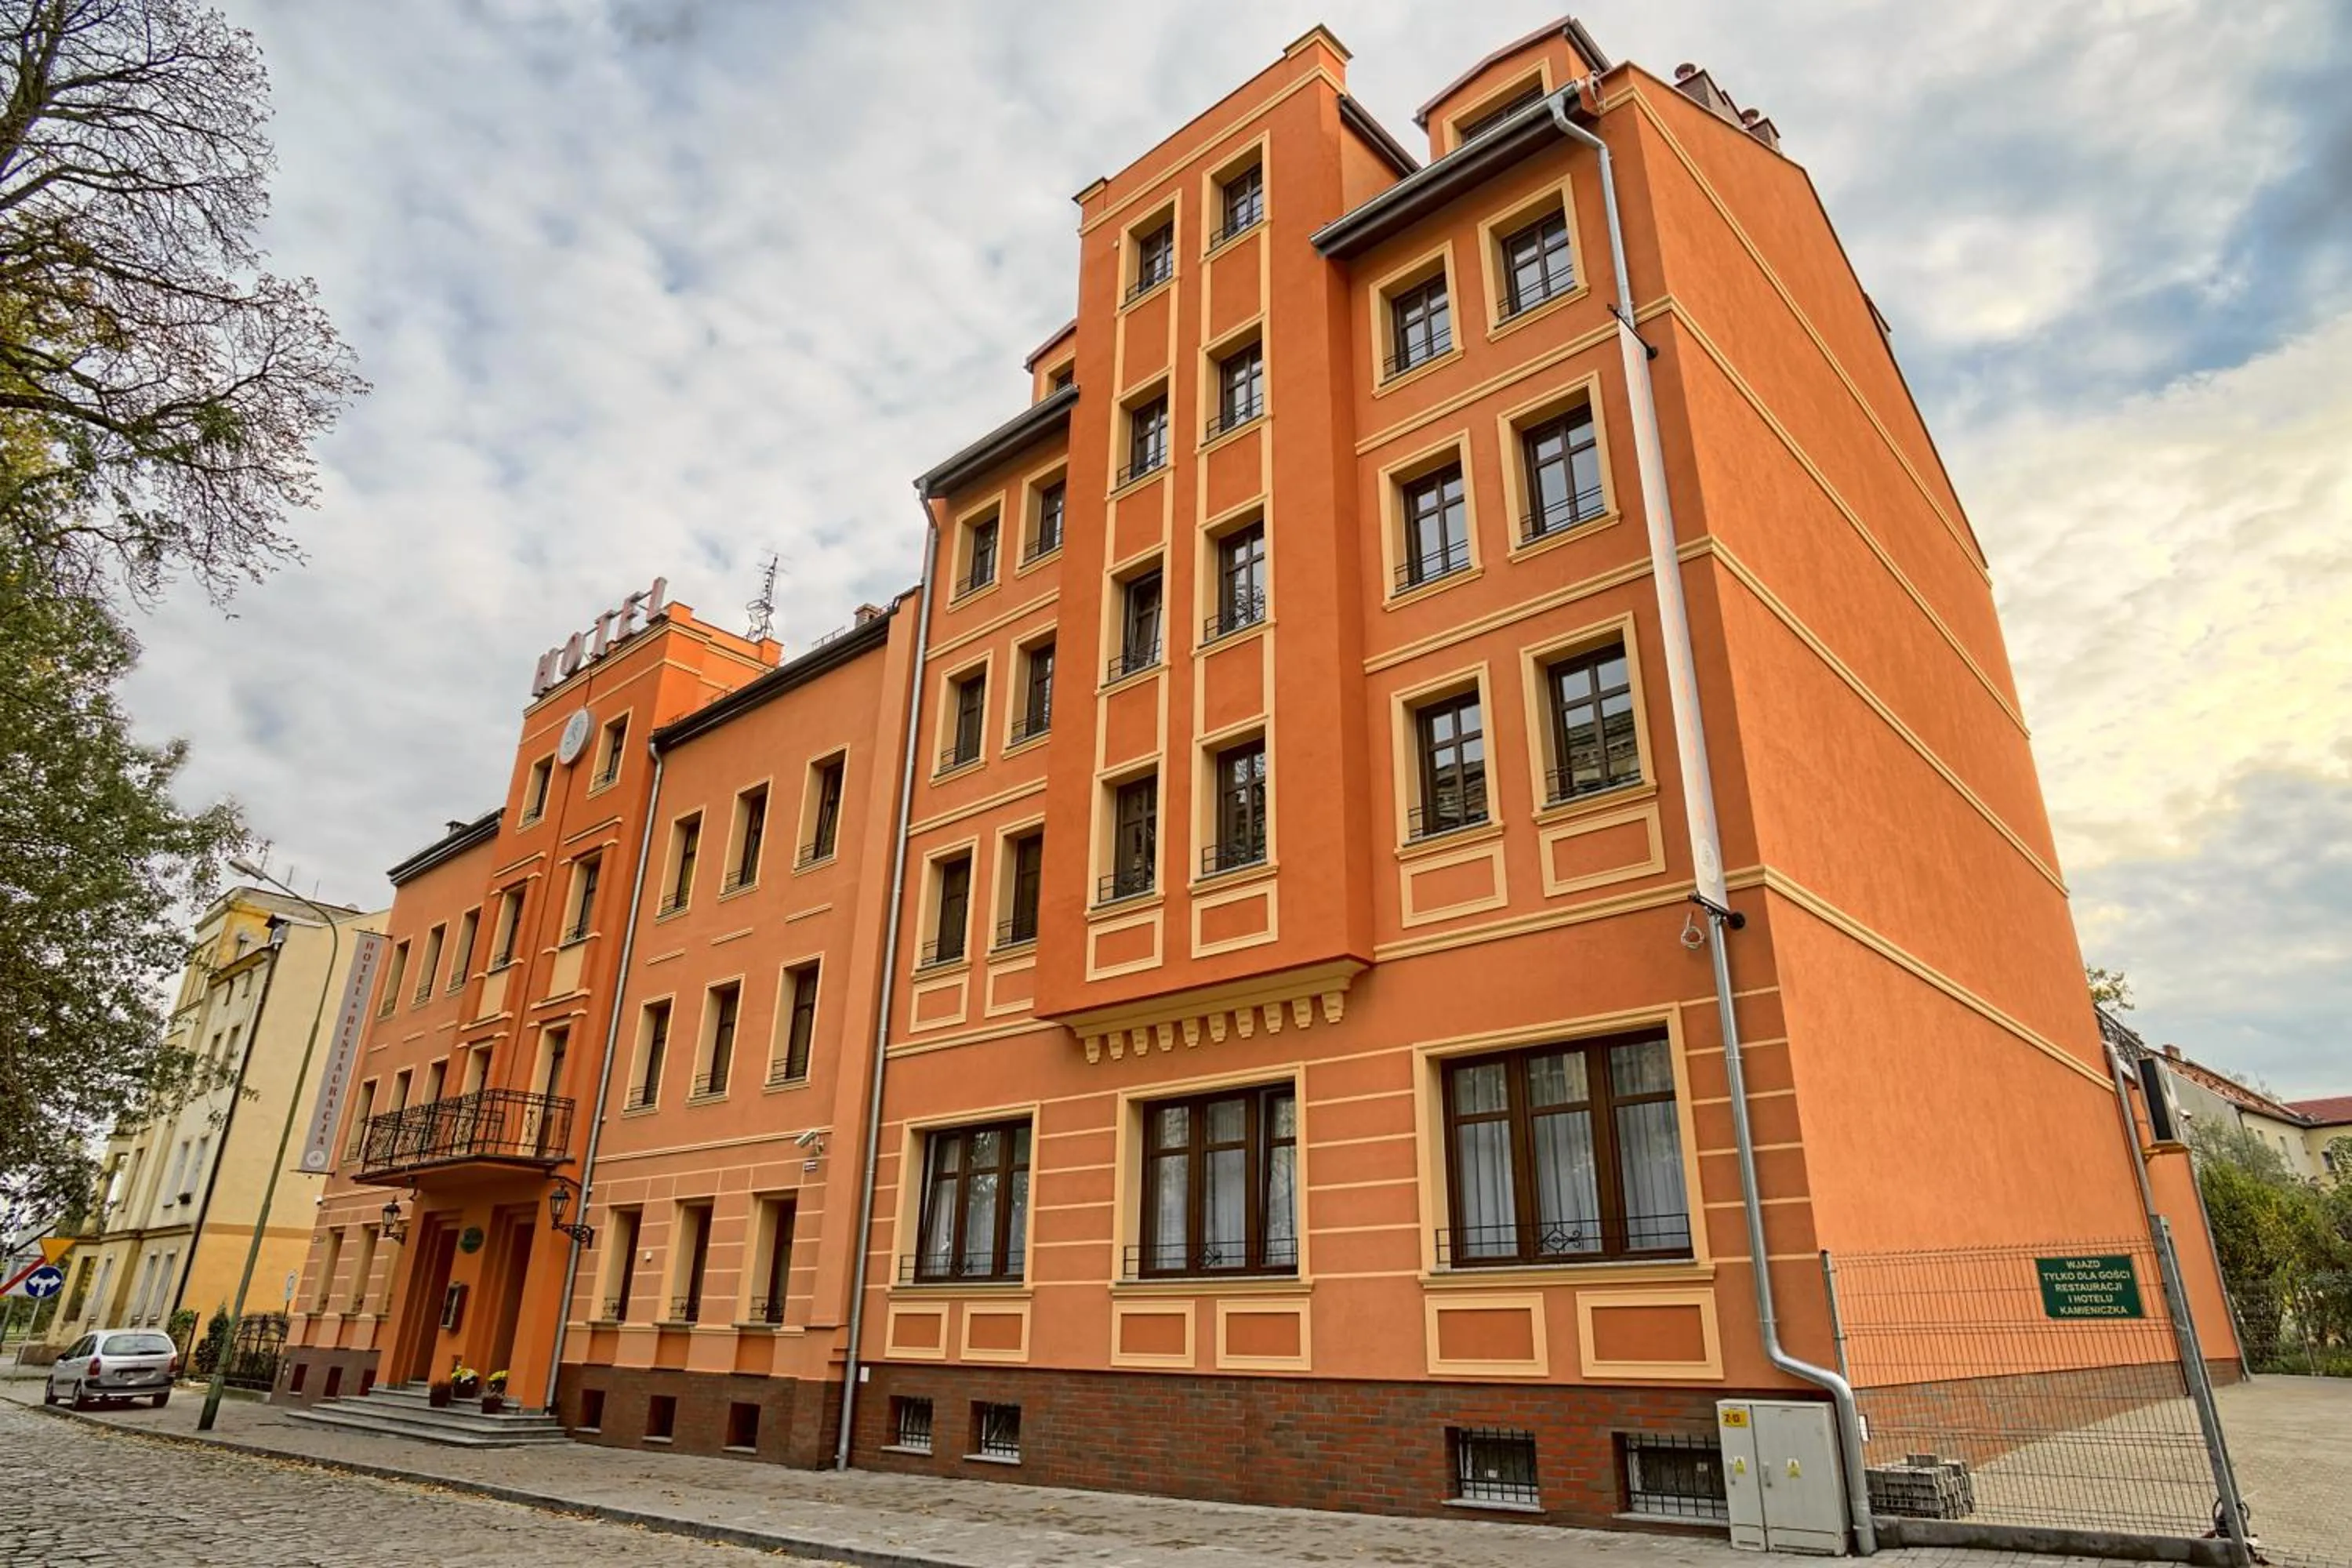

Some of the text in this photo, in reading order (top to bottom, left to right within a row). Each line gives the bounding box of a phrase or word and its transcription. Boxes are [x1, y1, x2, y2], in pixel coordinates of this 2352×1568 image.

[532, 577, 668, 696] HOTEL
[354, 942, 375, 996] HOTEL
[2066, 1260, 2100, 1269] WJAZD
[2042, 1269, 2131, 1281] TYLKO DLA GOŚCI
[2055, 1282, 2122, 1291] RESTAURACJI
[2074, 1294, 2114, 1303] HOTELU
[2058, 1305, 2129, 1315] KAMIENICZKA
